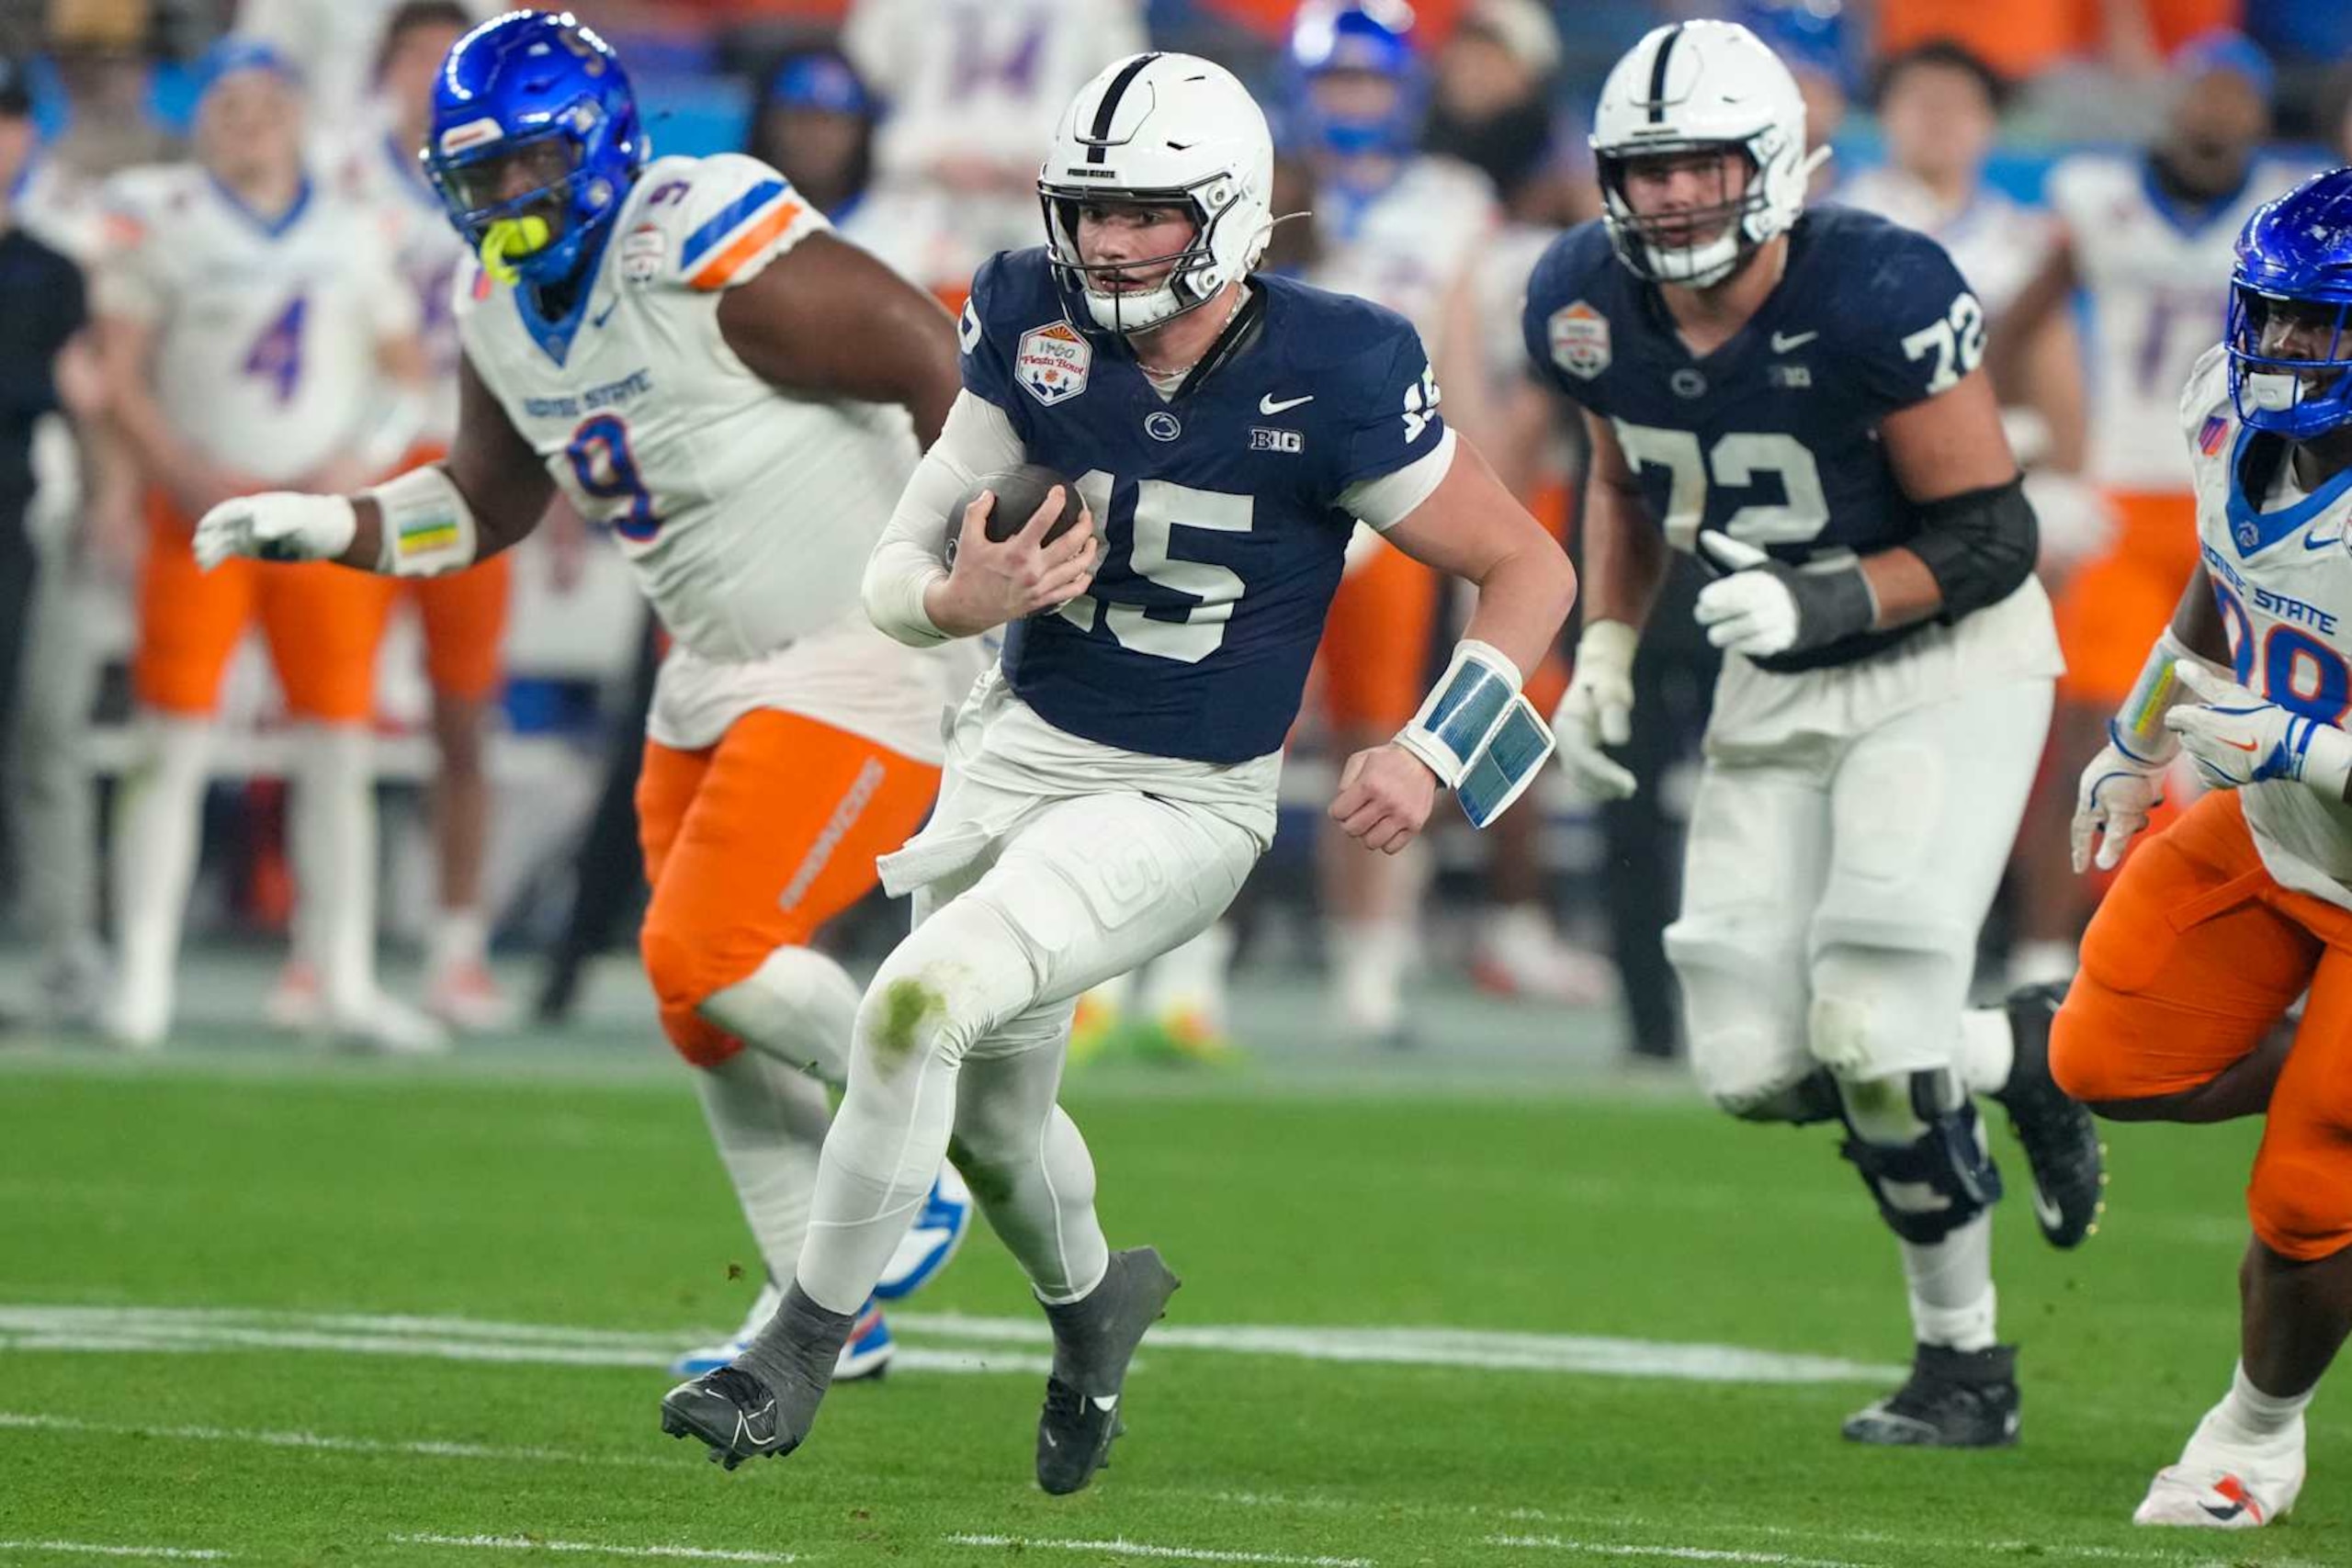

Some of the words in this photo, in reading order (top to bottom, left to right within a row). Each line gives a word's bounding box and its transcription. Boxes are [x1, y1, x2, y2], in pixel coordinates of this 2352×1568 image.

[241, 294, 311, 405] 4
[1022, 355, 1054, 367] Fiesta
[1057, 358, 1085, 375] Bowl
[1901, 291, 1988, 393] 72
[566, 413, 662, 544] 9
[1250, 427, 1303, 454] BIG
[1611, 415, 1831, 562] 72
[1057, 468, 1255, 664] 15
[2254, 587, 2338, 637] STATE
